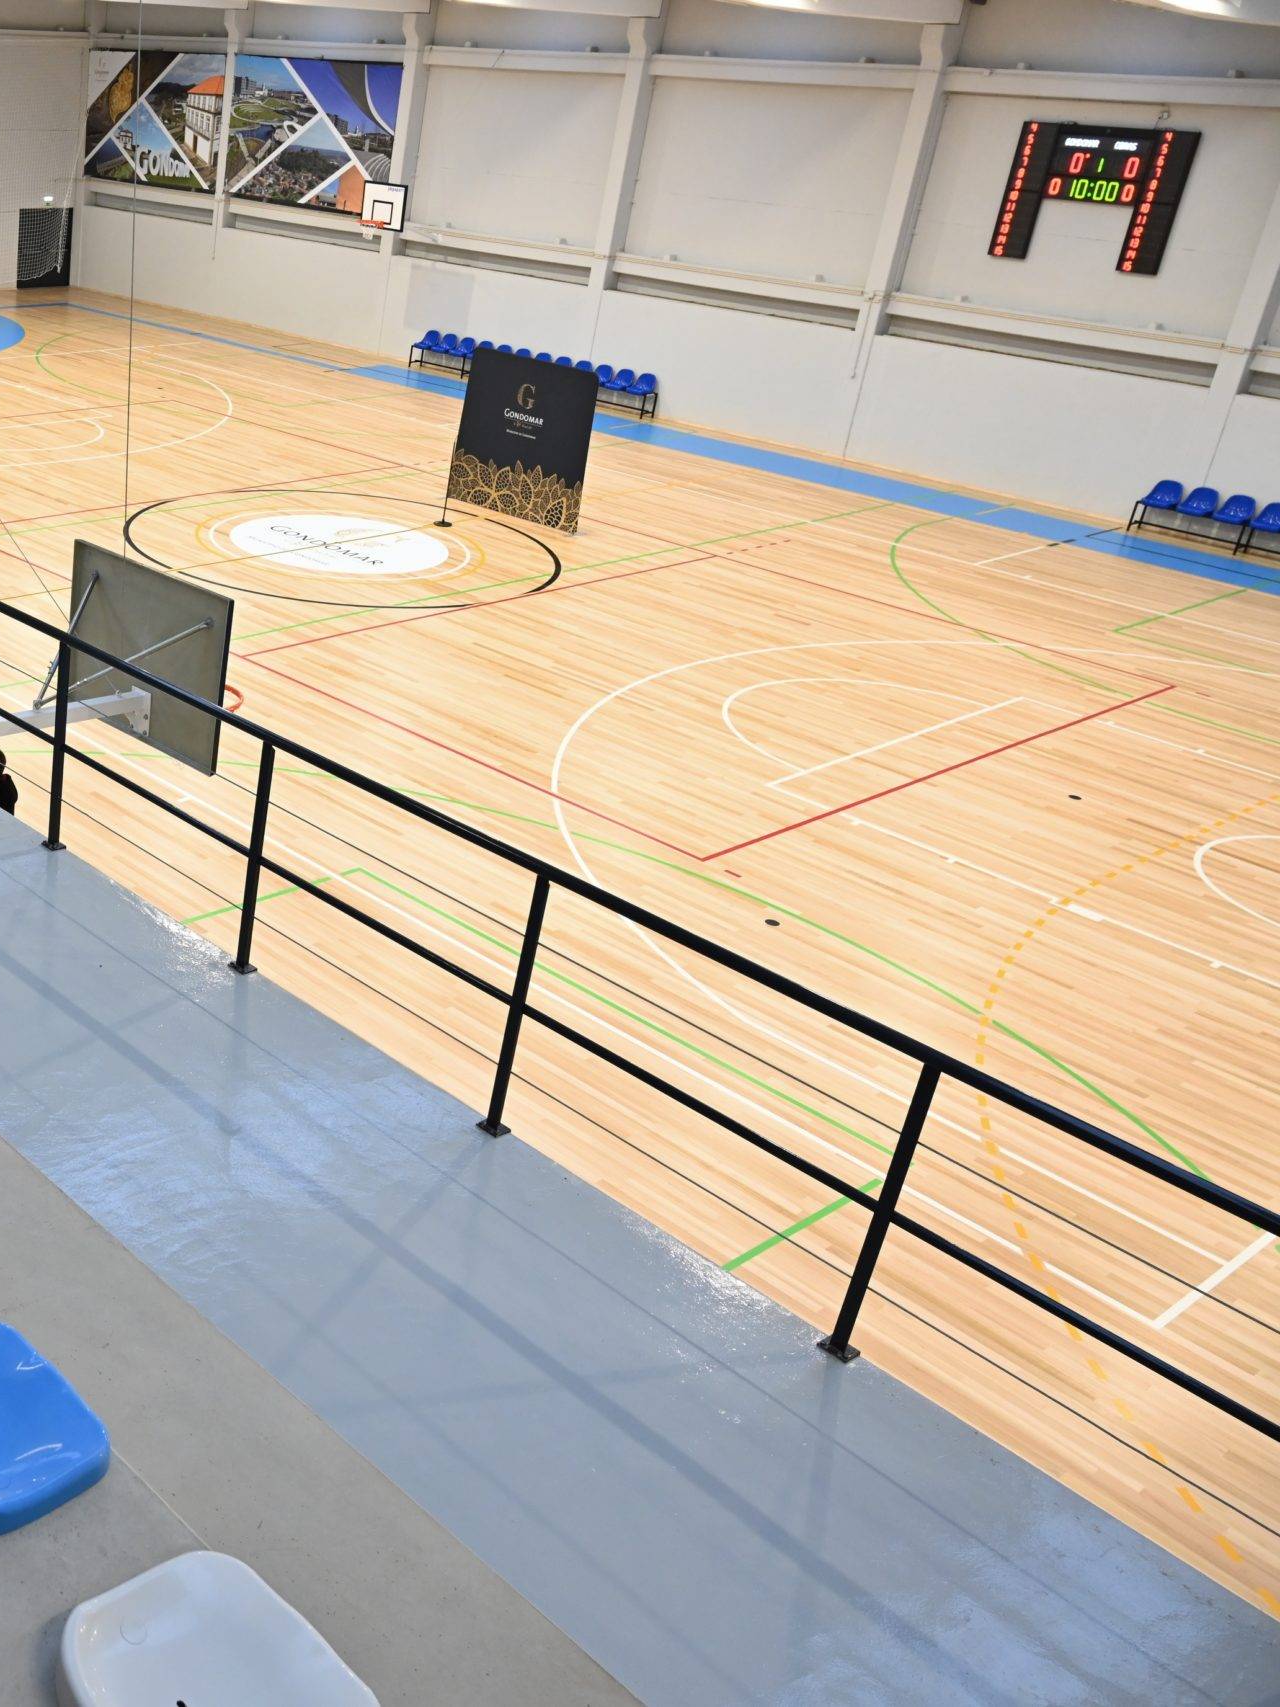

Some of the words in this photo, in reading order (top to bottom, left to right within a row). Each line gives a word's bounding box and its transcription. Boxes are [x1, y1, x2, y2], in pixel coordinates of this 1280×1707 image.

[1069, 152, 1085, 174] 0
[1098, 157, 1105, 173] 1
[1123, 156, 1140, 179] 0
[1048, 177, 1062, 195] 0
[1069, 178, 1120, 202] 10:00
[1120, 184, 1135, 202] 0
[517, 383, 536, 410] G
[504, 408, 544, 426] GONDOMAR
[270, 525, 384, 565] GONDOMAR
